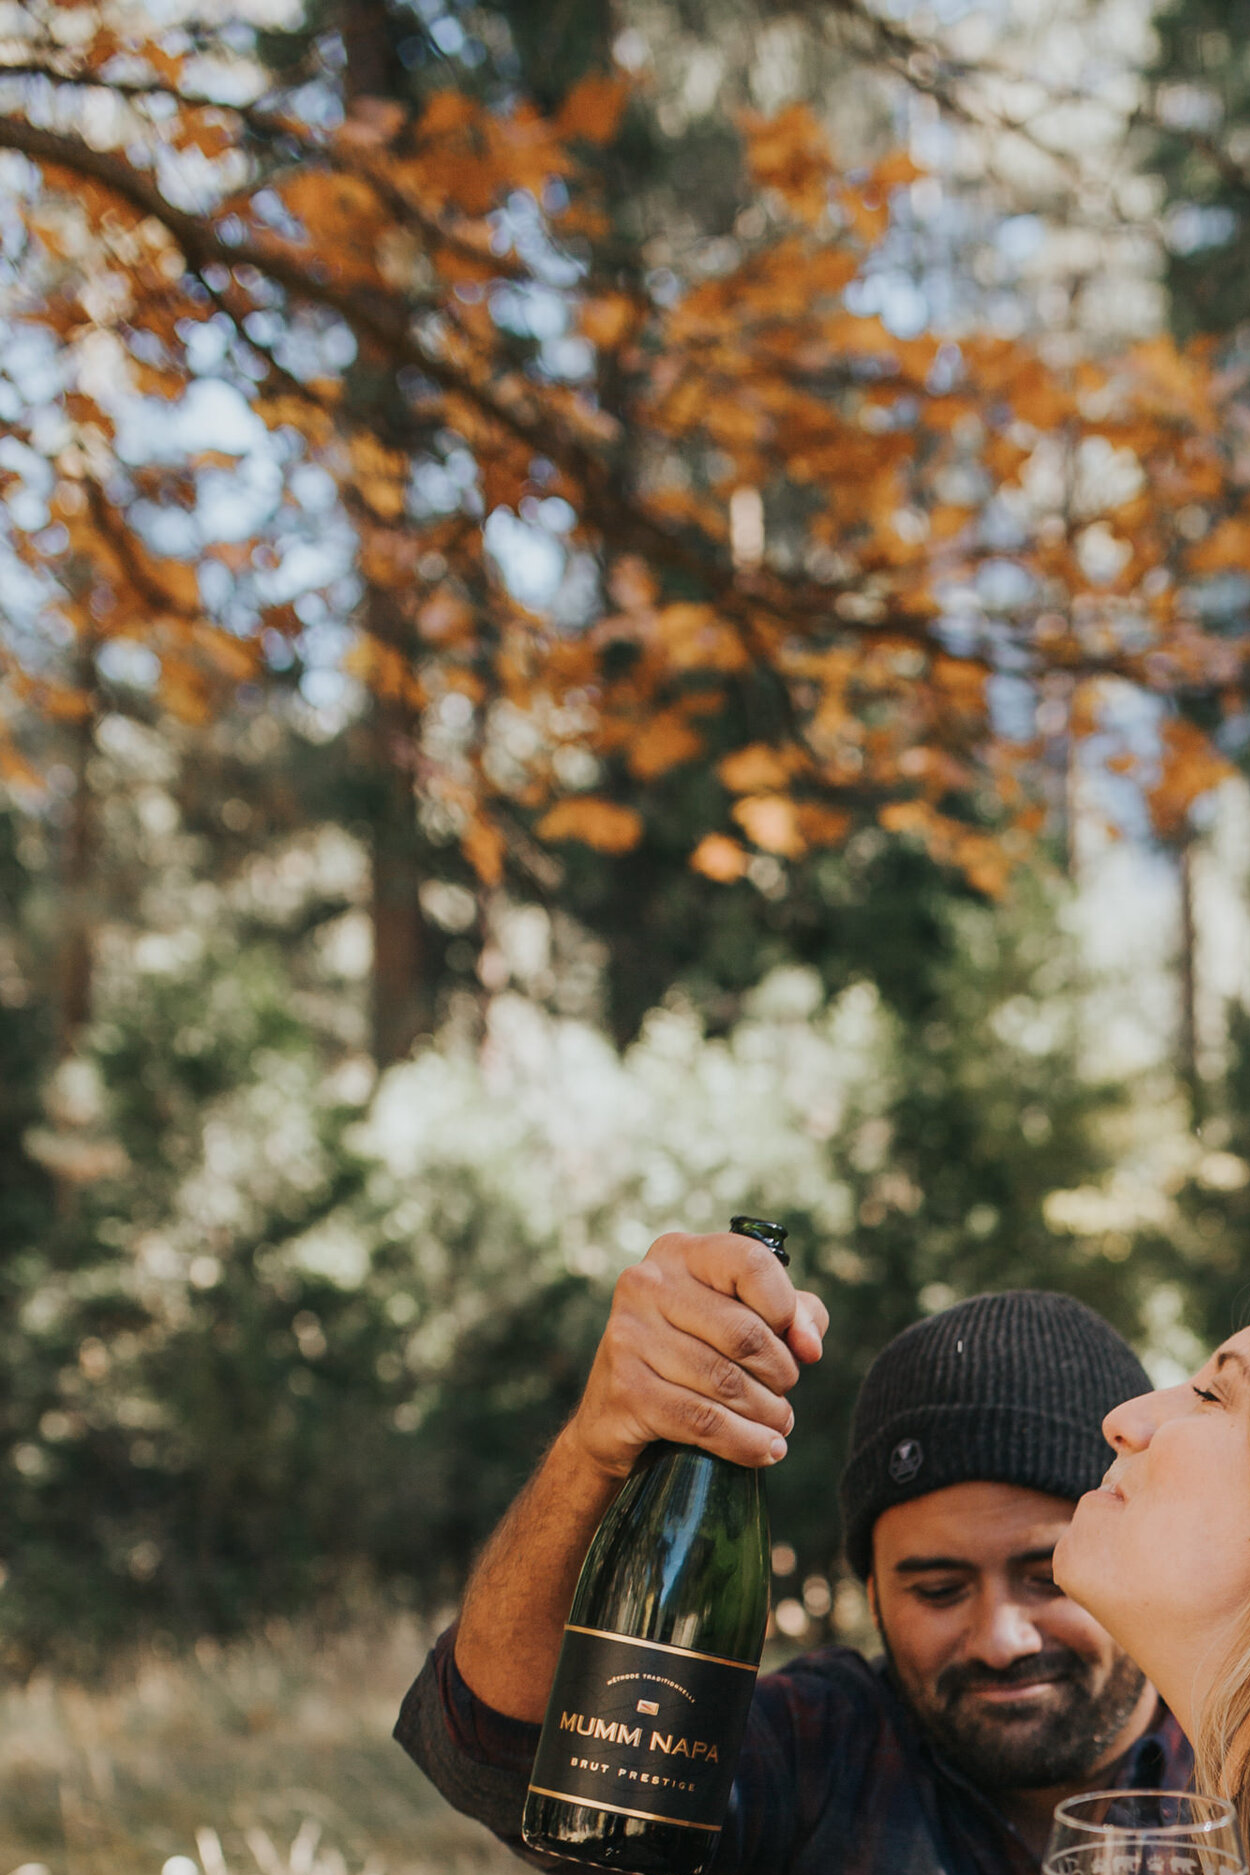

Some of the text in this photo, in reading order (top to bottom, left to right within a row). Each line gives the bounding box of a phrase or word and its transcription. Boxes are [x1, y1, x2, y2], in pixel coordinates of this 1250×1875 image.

[560, 1711, 719, 1764] MUMM NAPA
[570, 1757, 696, 1792] BRUT PRESTIGE
